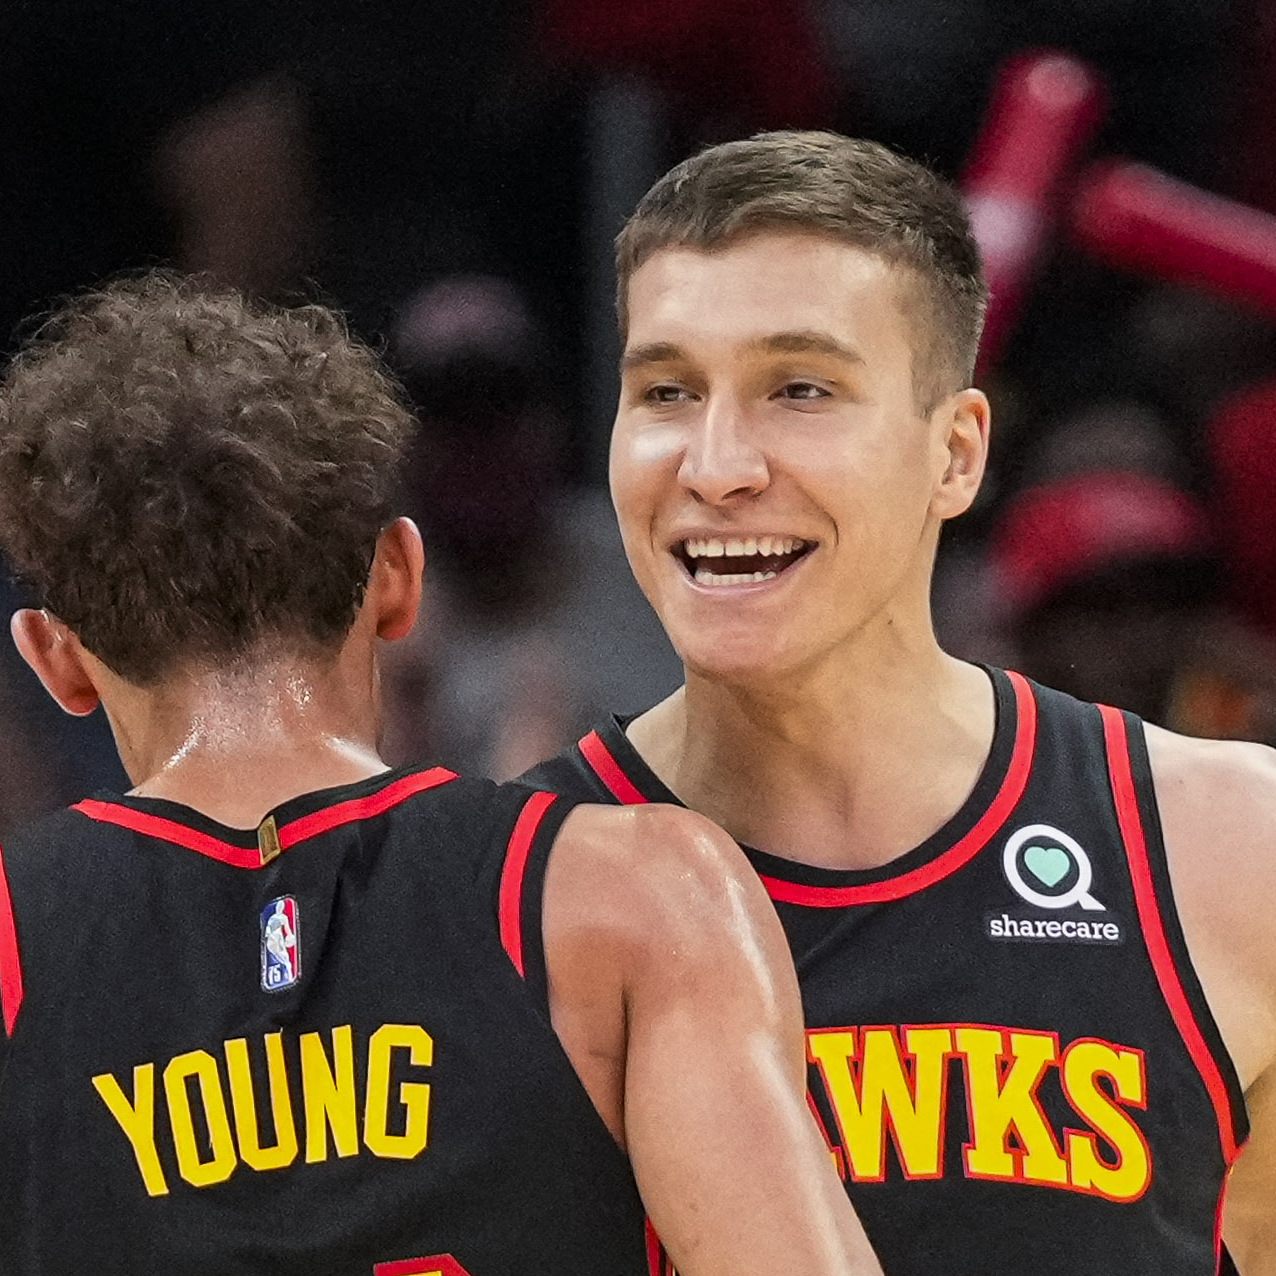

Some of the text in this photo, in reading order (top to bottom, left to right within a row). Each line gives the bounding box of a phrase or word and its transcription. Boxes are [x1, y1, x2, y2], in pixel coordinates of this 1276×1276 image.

[990, 914, 1120, 940] sharecare
[92, 1022, 434, 1198] YOUNG
[805, 1023, 1153, 1204] WKS
